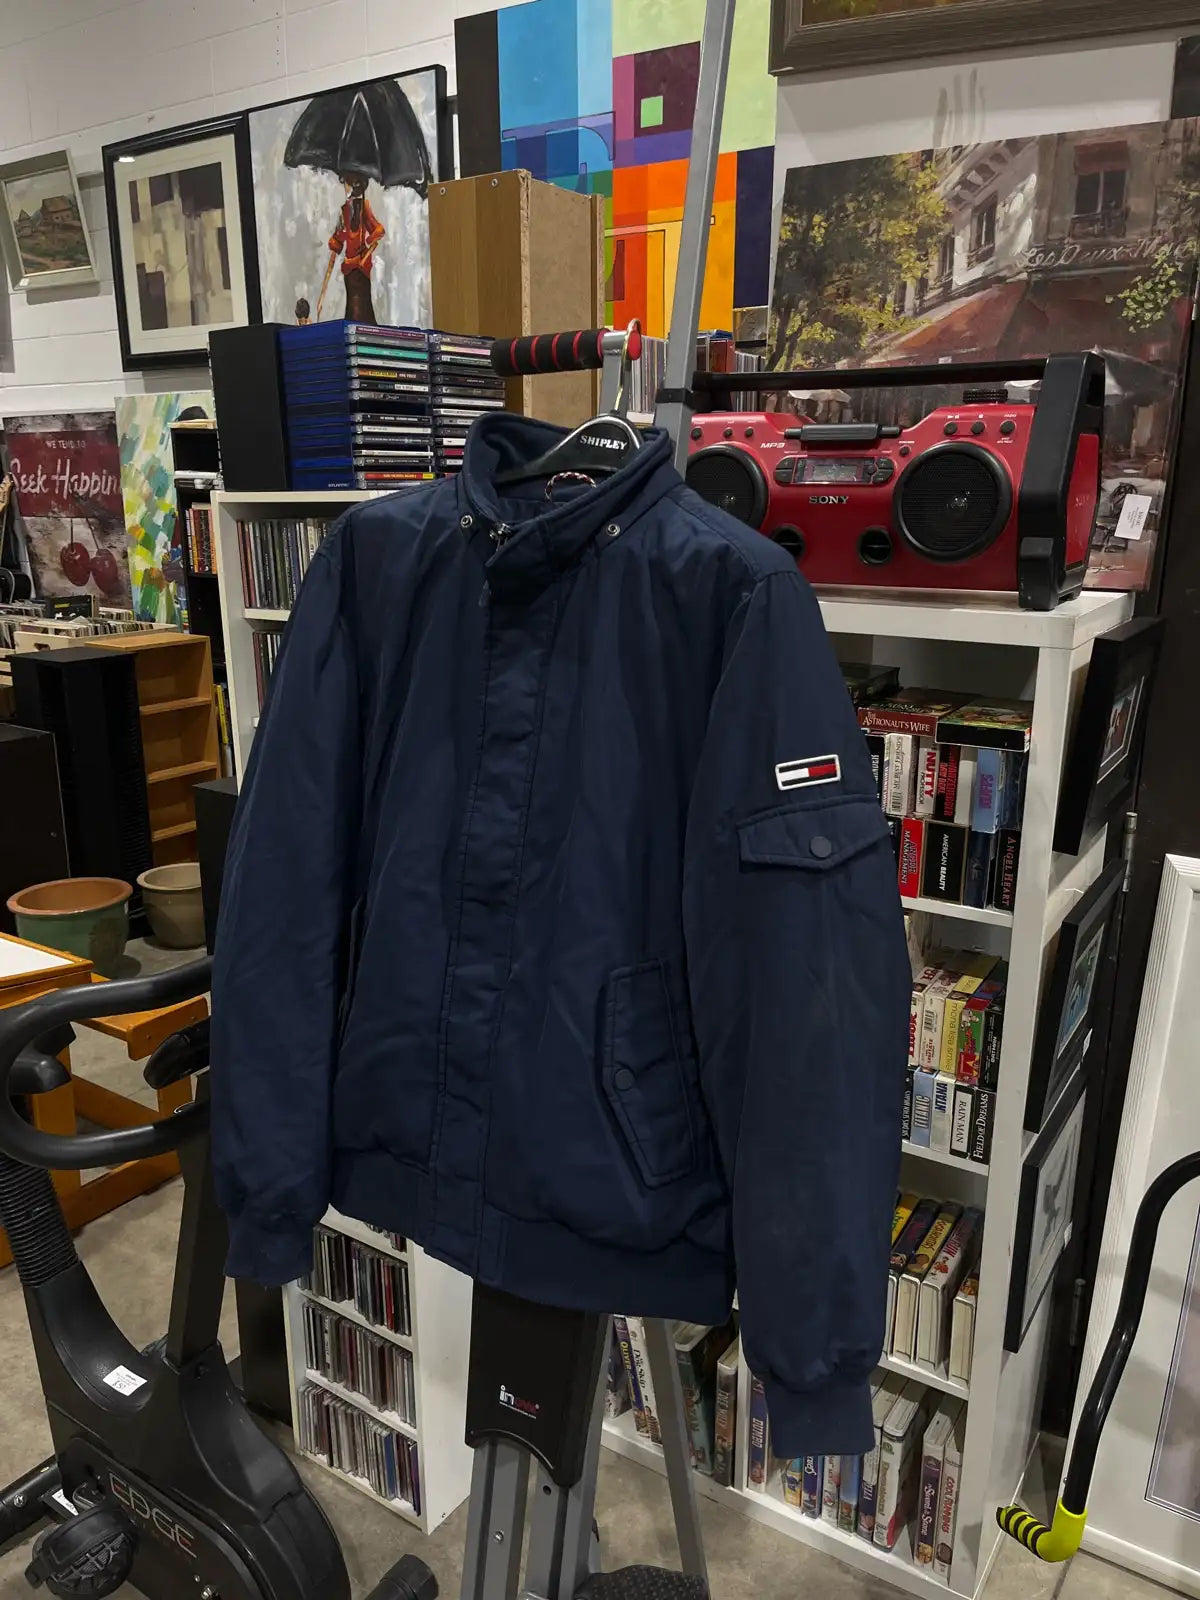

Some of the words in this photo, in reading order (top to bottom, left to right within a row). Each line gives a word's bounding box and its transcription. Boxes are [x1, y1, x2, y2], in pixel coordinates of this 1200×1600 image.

[580, 435, 627, 450] SHIPLEY
[51, 459, 122, 499] Happin
[808, 495, 849, 504] SONY
[910, 720, 930, 732] WIFE
[925, 751, 936, 798] NUTTY
[901, 830, 911, 884] MANAGEMENT
[940, 834, 949, 866] AMERICAN
[1004, 837, 1016, 871] ANGEL
[939, 866, 947, 891] BEAUTY
[1002, 872, 1013, 906] HEART
[914, 1095, 931, 1129] TITANIC
[935, 1083, 947, 1113] NTANA
[958, 1100, 967, 1122] RAIN
[976, 1093, 988, 1126] DREAMS
[956, 1122, 964, 1143] MAN
[973, 1135, 984, 1159] FIELD
[621, 1341, 631, 1370] OLIVER
[751, 1418, 763, 1448] DUMBO
[945, 1476, 955, 1497] COOL
[109, 1472, 197, 1558] EDGE
